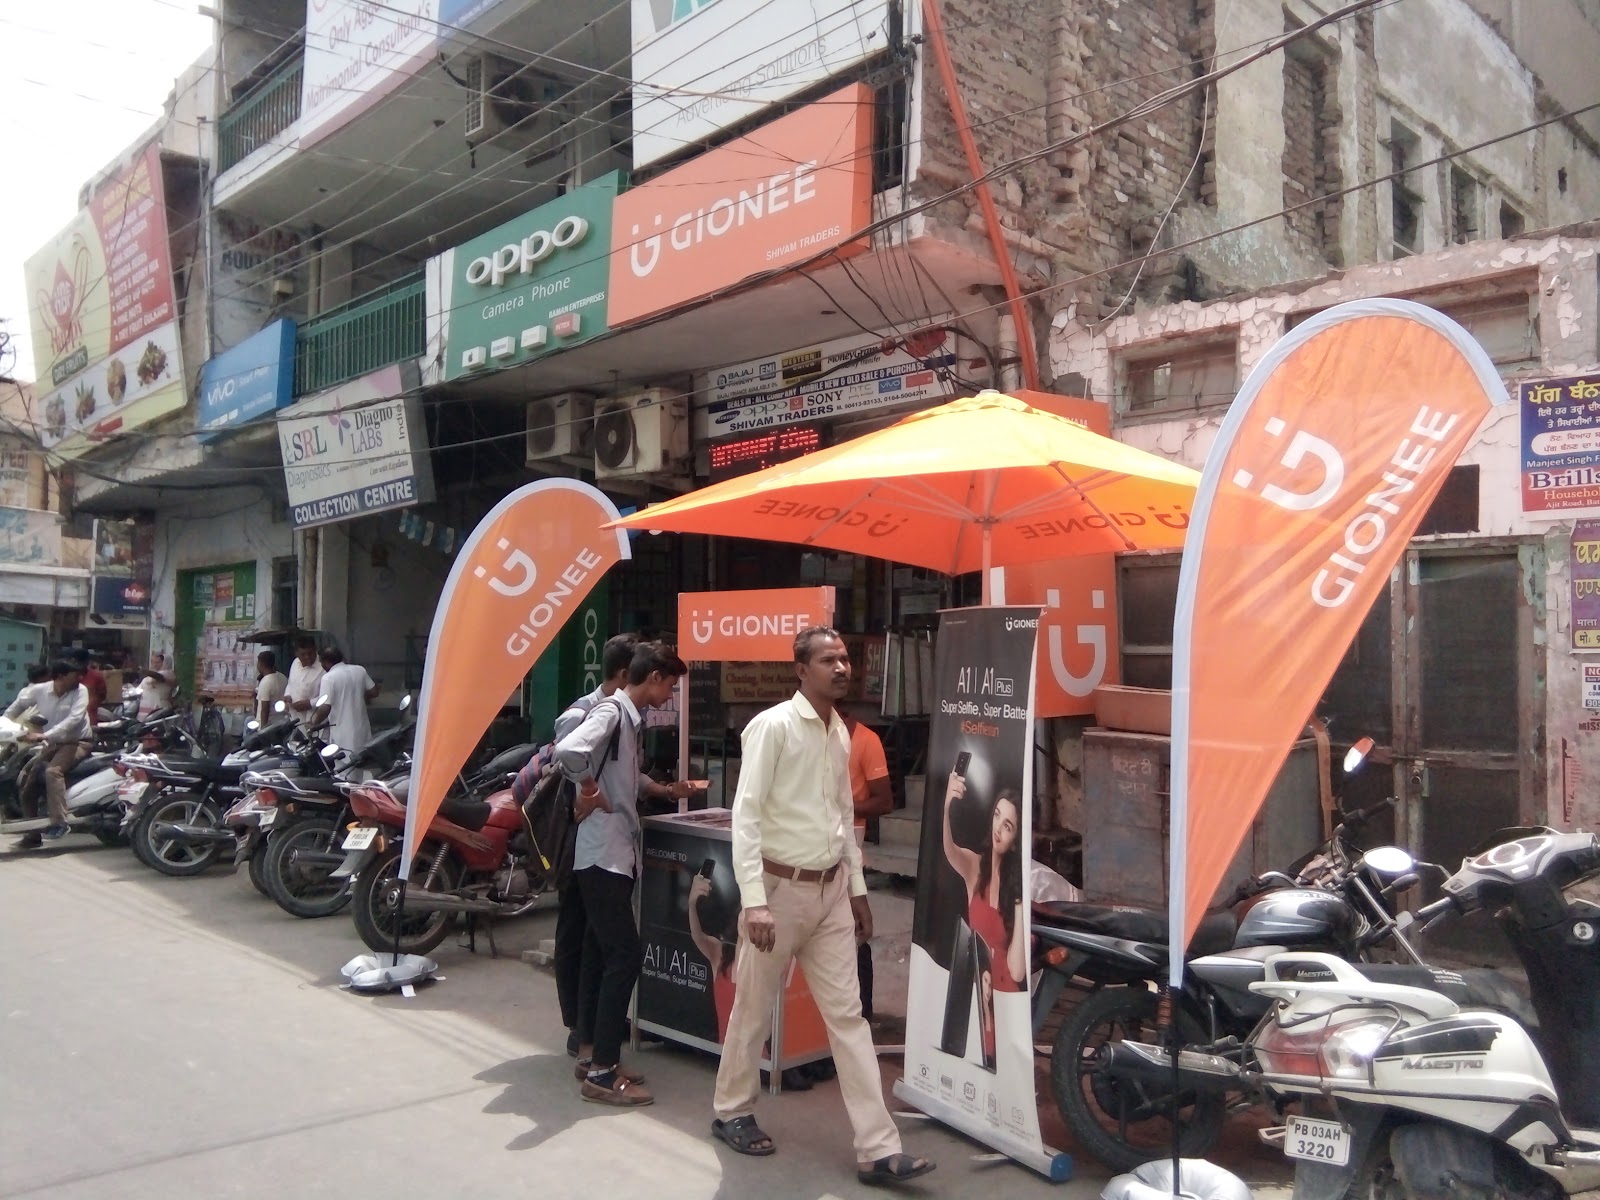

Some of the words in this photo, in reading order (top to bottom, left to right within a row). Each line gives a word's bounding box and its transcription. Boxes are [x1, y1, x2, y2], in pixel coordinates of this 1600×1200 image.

[329, 15, 351, 50] Only
[306, 57, 362, 113] Matrimonial
[365, 1, 431, 67] Consultant's
[755, 38, 826, 87] Solutions
[671, 160, 817, 251] GIONEE
[766, 242, 797, 261] SHIVAM
[799, 226, 840, 250] TRADERS
[482, 295, 524, 320] Camera
[531, 277, 571, 302] Phone
[569, 291, 605, 312] ENTERPRISES
[782, 353, 816, 367] WESTERN
[727, 398, 745, 409] DEALS
[767, 388, 797, 401] COMPANY
[800, 381, 824, 394] MOBILE
[824, 378, 840, 390] NEW
[846, 374, 860, 385] OLD
[861, 370, 879, 381] SALE
[886, 362, 925, 378] PURCHASE
[728, 368, 754, 380] BAJAJ
[807, 390, 844, 407] SONY
[1528, 384, 1562, 404] ਪੱਗ
[354, 406, 393, 430] Diagno
[730, 416, 774, 431] SHIVAM
[777, 404, 834, 422] TRADERS
[292, 425, 328, 462] SRL
[1526, 458, 1564, 468] Manjeet
[1567, 455, 1592, 465] Singh
[294, 493, 360, 524] COLLECTION
[364, 479, 413, 508] CENTRE
[1311, 405, 1458, 608] GIONEE
[507, 548, 602, 656] GIONEE
[867, 643, 886, 672] SHI
[733, 688, 756, 698] Video
[757, 688, 782, 698] Games
[957, 667, 971, 694] A1
[981, 667, 994, 695] A1
[996, 681, 1012, 694] Plus
[941, 699, 958, 716] Super
[958, 701, 981, 716] Selfie,
[983, 702, 1001, 720] Super
[646, 847, 677, 861] WELCOME
[677, 852, 687, 862] TO
[643, 943, 660, 968] A1
[669, 950, 687, 976] A1
[690, 964, 706, 979] Plus
[642, 966, 657, 977] Super
[672, 974, 687, 986] Super
[688, 978, 707, 993] Battery
[1294, 1123, 1309, 1136] PB
[1311, 1126, 1341, 1141] 03AH
[1297, 1140, 1335, 1159] 3220
